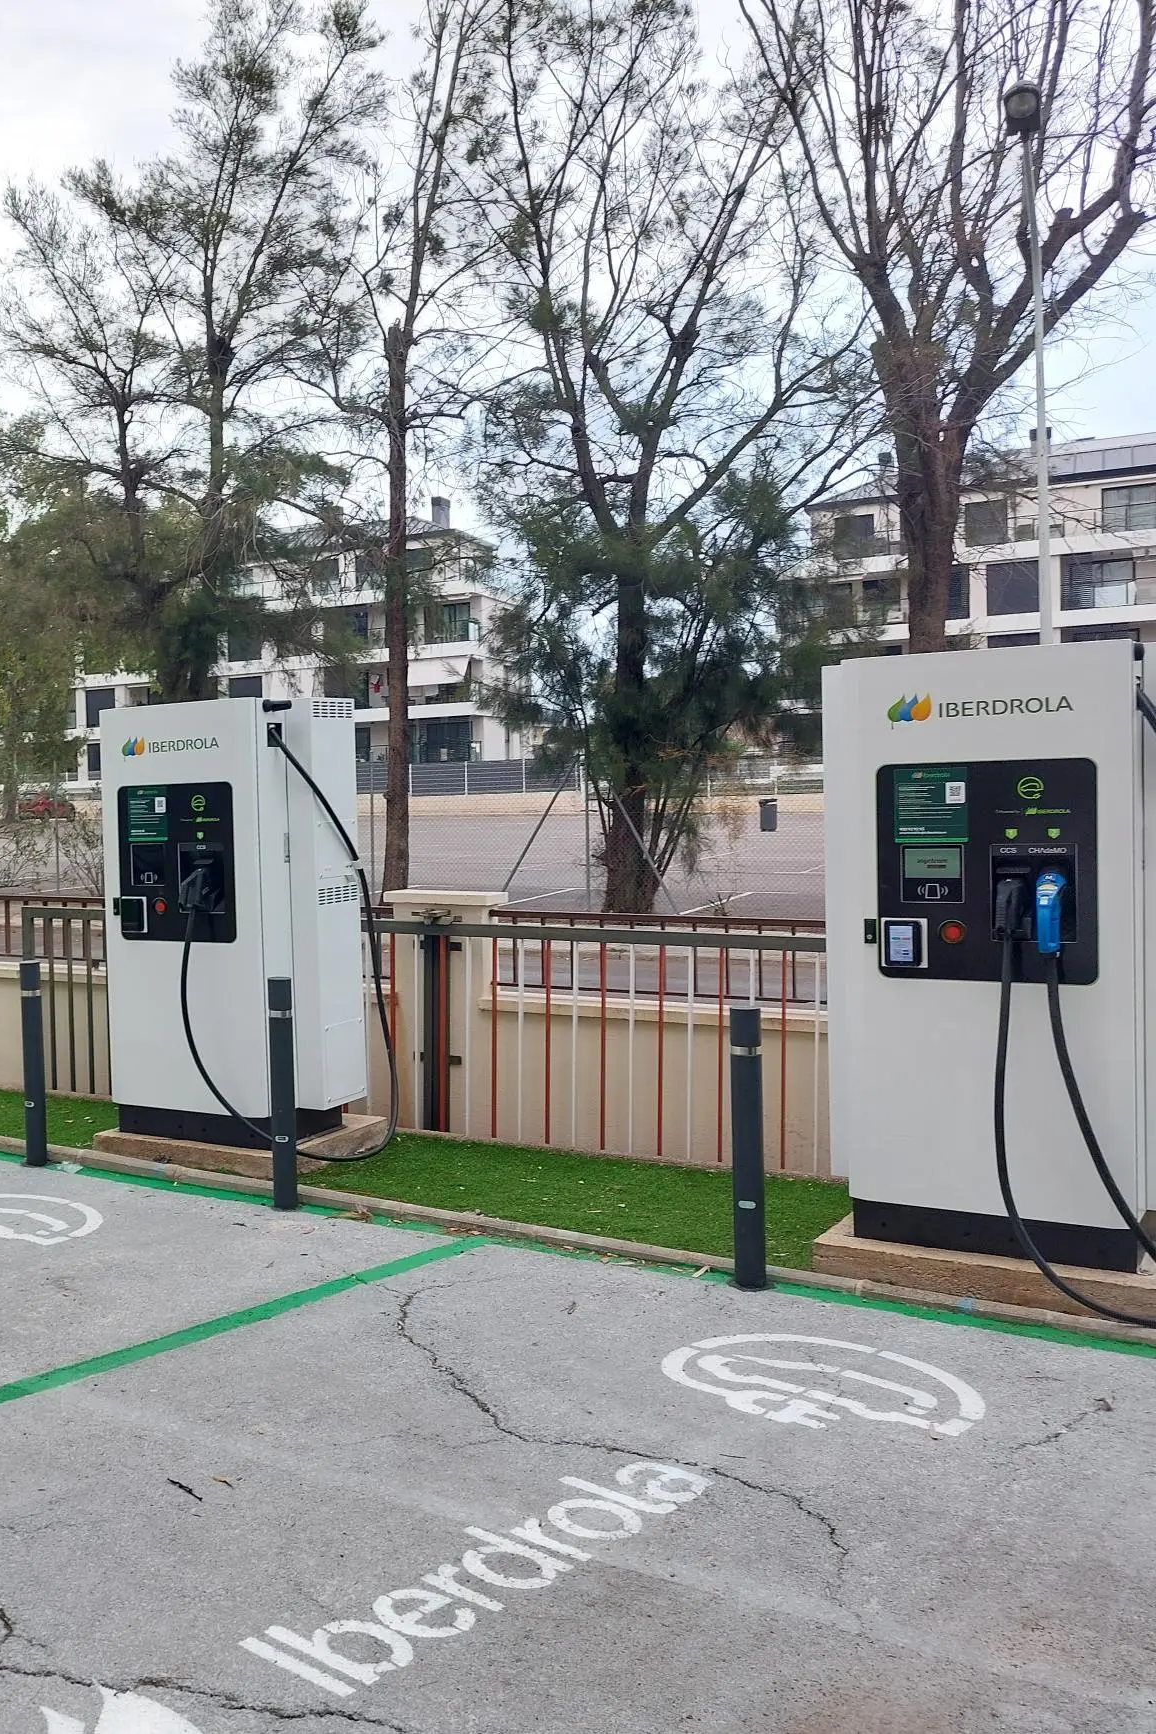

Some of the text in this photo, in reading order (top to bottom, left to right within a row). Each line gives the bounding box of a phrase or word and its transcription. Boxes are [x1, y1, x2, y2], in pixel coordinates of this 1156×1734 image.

[938, 695, 1074, 718] IBERDROLA
[148, 736, 220, 753] IBERDROLA
[237, 1460, 716, 1698] Iberdrola
